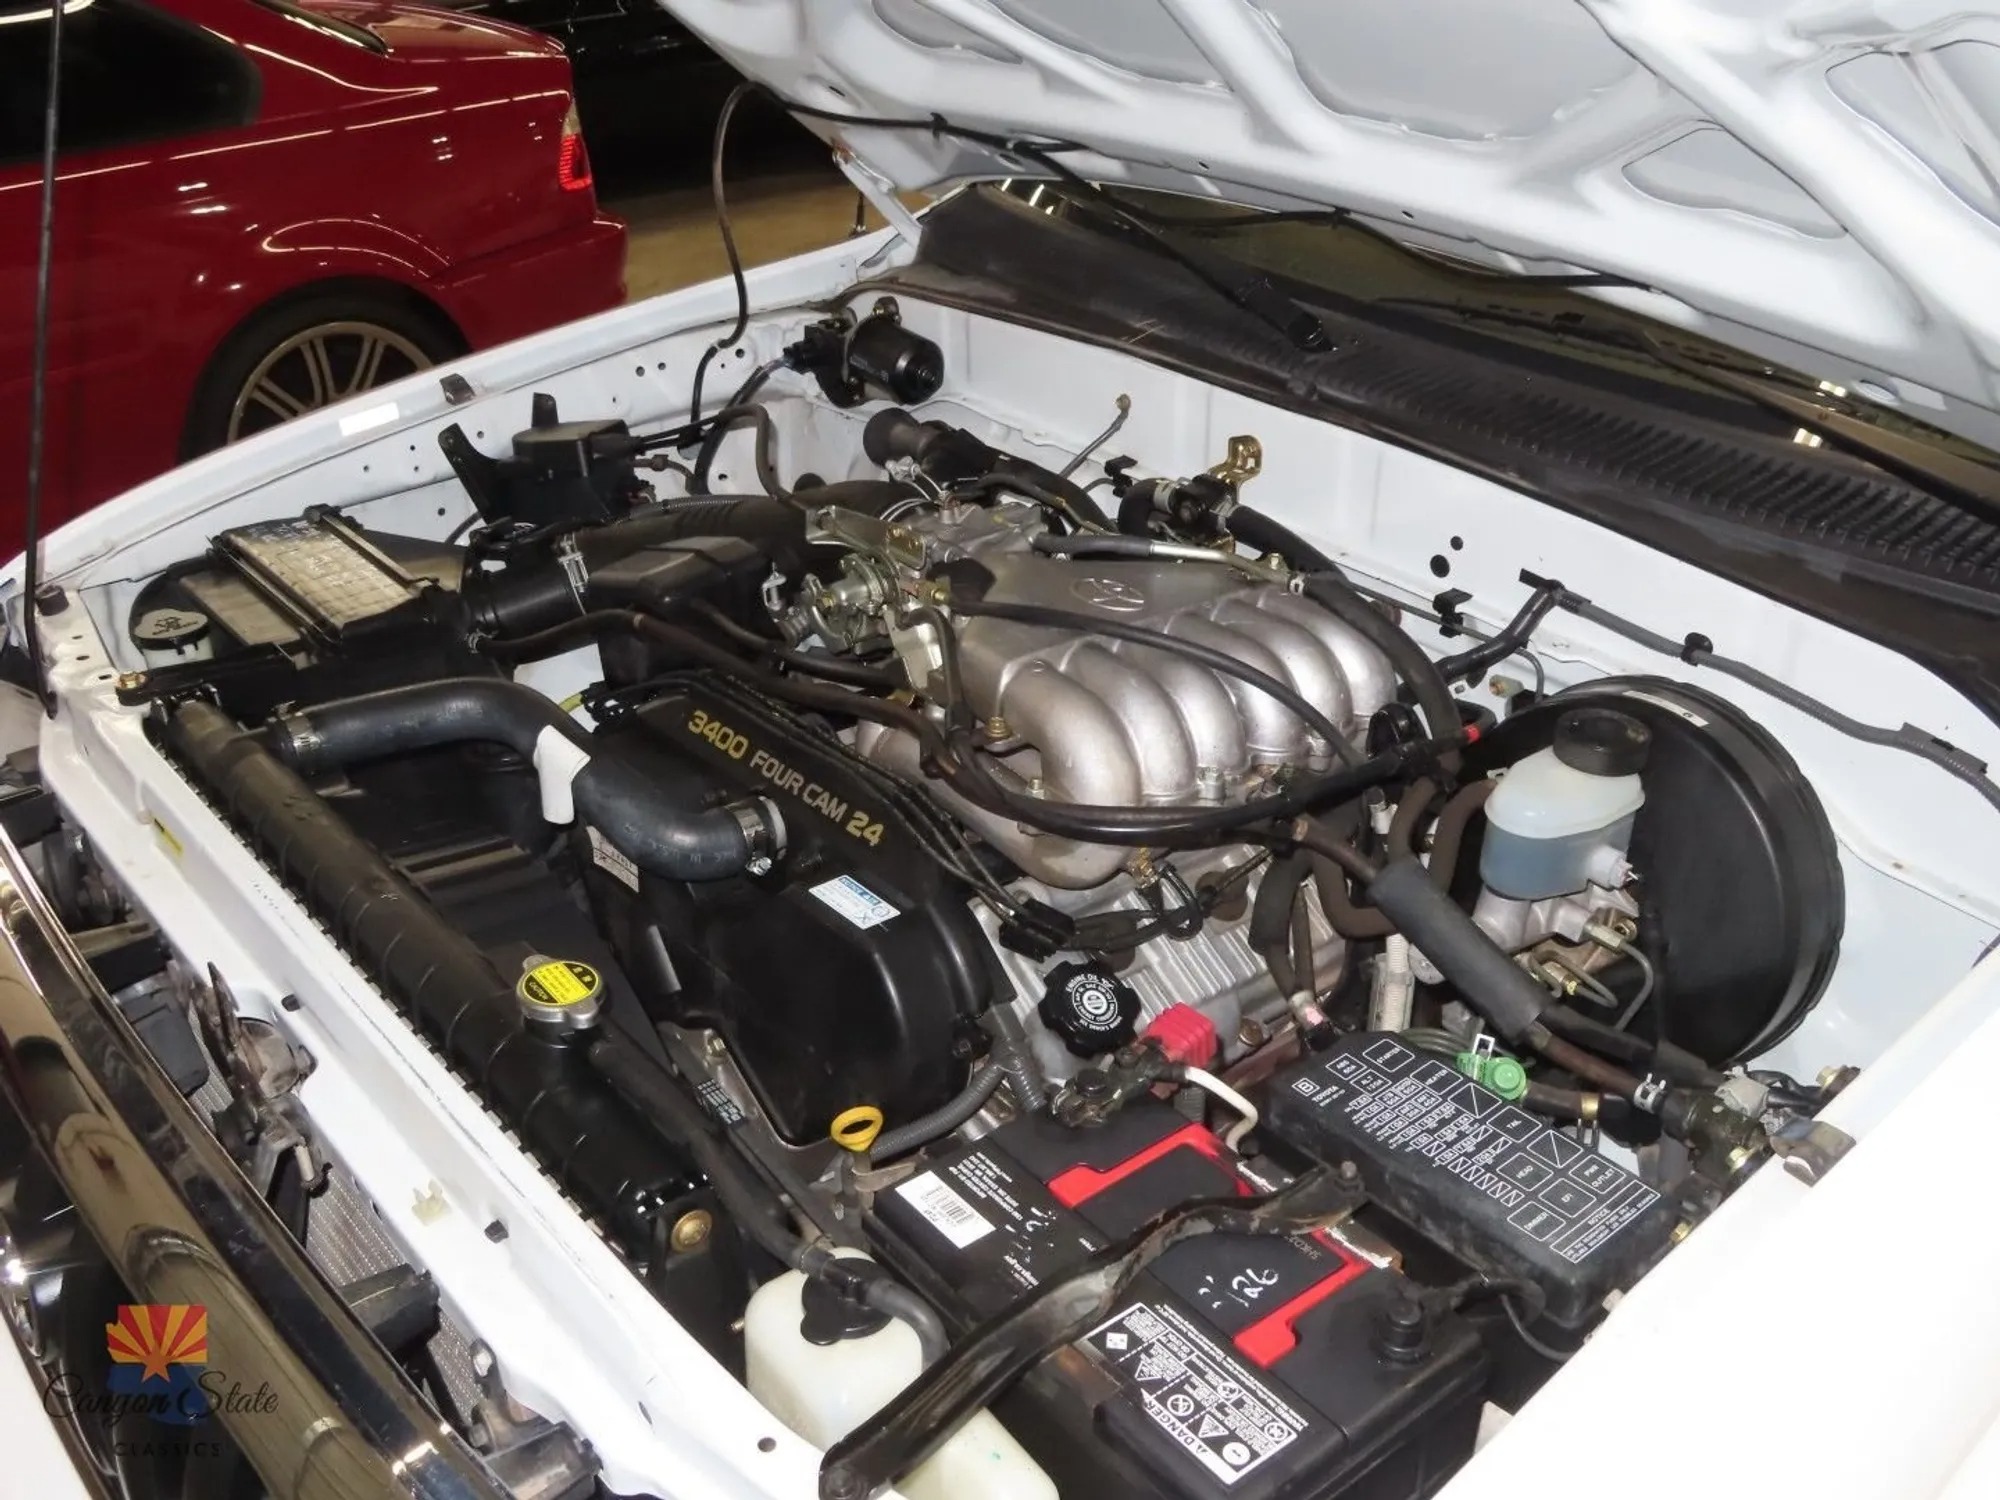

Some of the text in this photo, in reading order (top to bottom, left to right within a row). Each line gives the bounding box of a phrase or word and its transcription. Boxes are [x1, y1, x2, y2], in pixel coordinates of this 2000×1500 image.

[688, 710, 885, 847] 3400 FOUR CAM 24
[1376, 1048, 1401, 1063] STARTER
[1425, 1069, 1447, 1084] HEATER
[1312, 1085, 1339, 1102] TOYOTA
[1515, 1165, 1533, 1178] HEAD
[1591, 1169, 1614, 1187] OUTLET
[1523, 1211, 1549, 1230] DIMMER
[1588, 1208, 1610, 1225] NOTICE
[1148, 1396, 1195, 1445] DANGER
